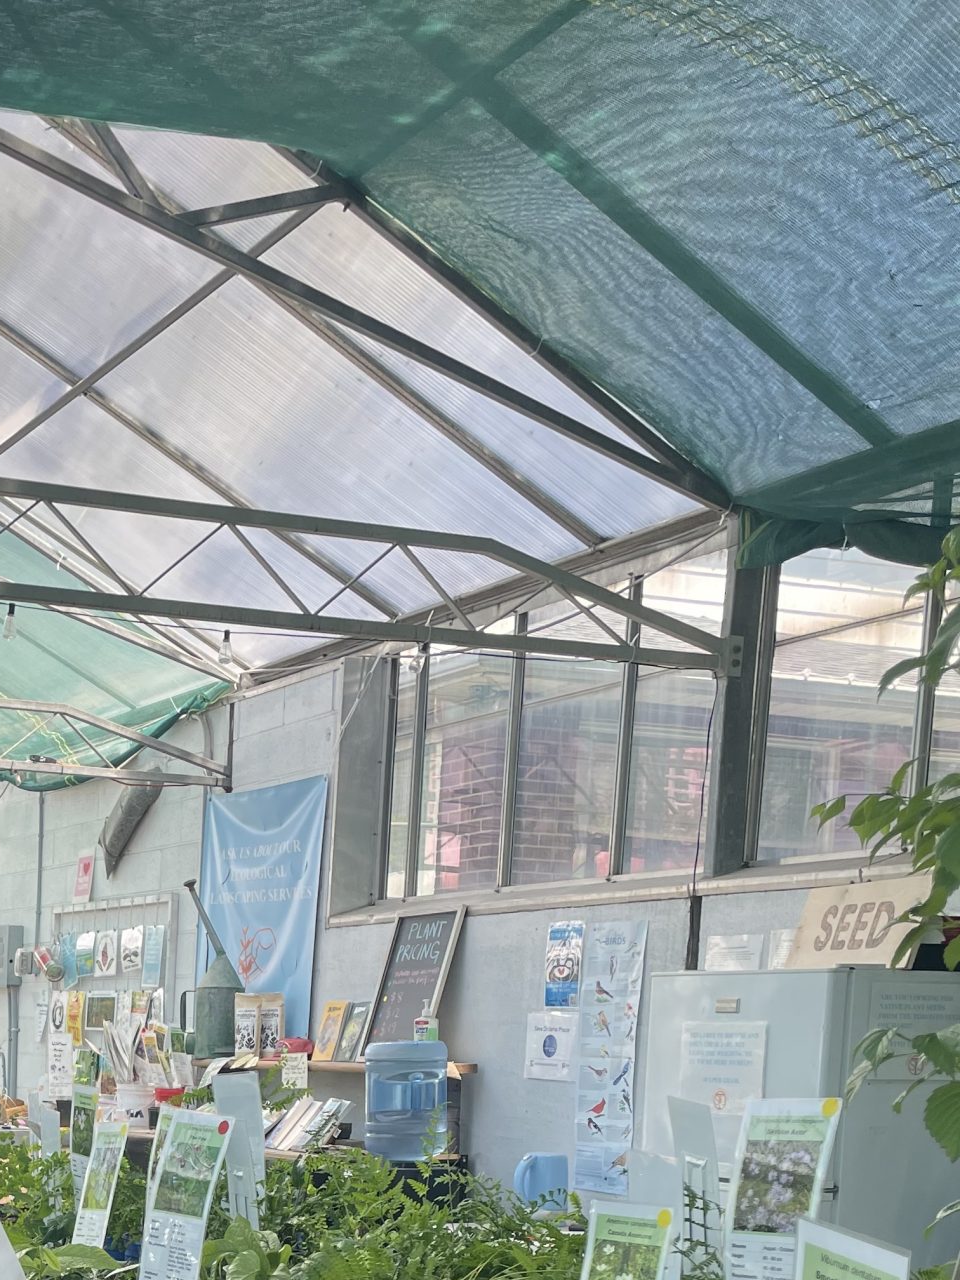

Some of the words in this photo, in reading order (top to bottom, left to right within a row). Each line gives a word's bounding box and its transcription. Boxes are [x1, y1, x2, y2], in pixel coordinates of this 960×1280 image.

[408, 920, 448, 940] PLANT
[813, 901, 896, 952] SEED
[395, 941, 441, 965] PRICING
